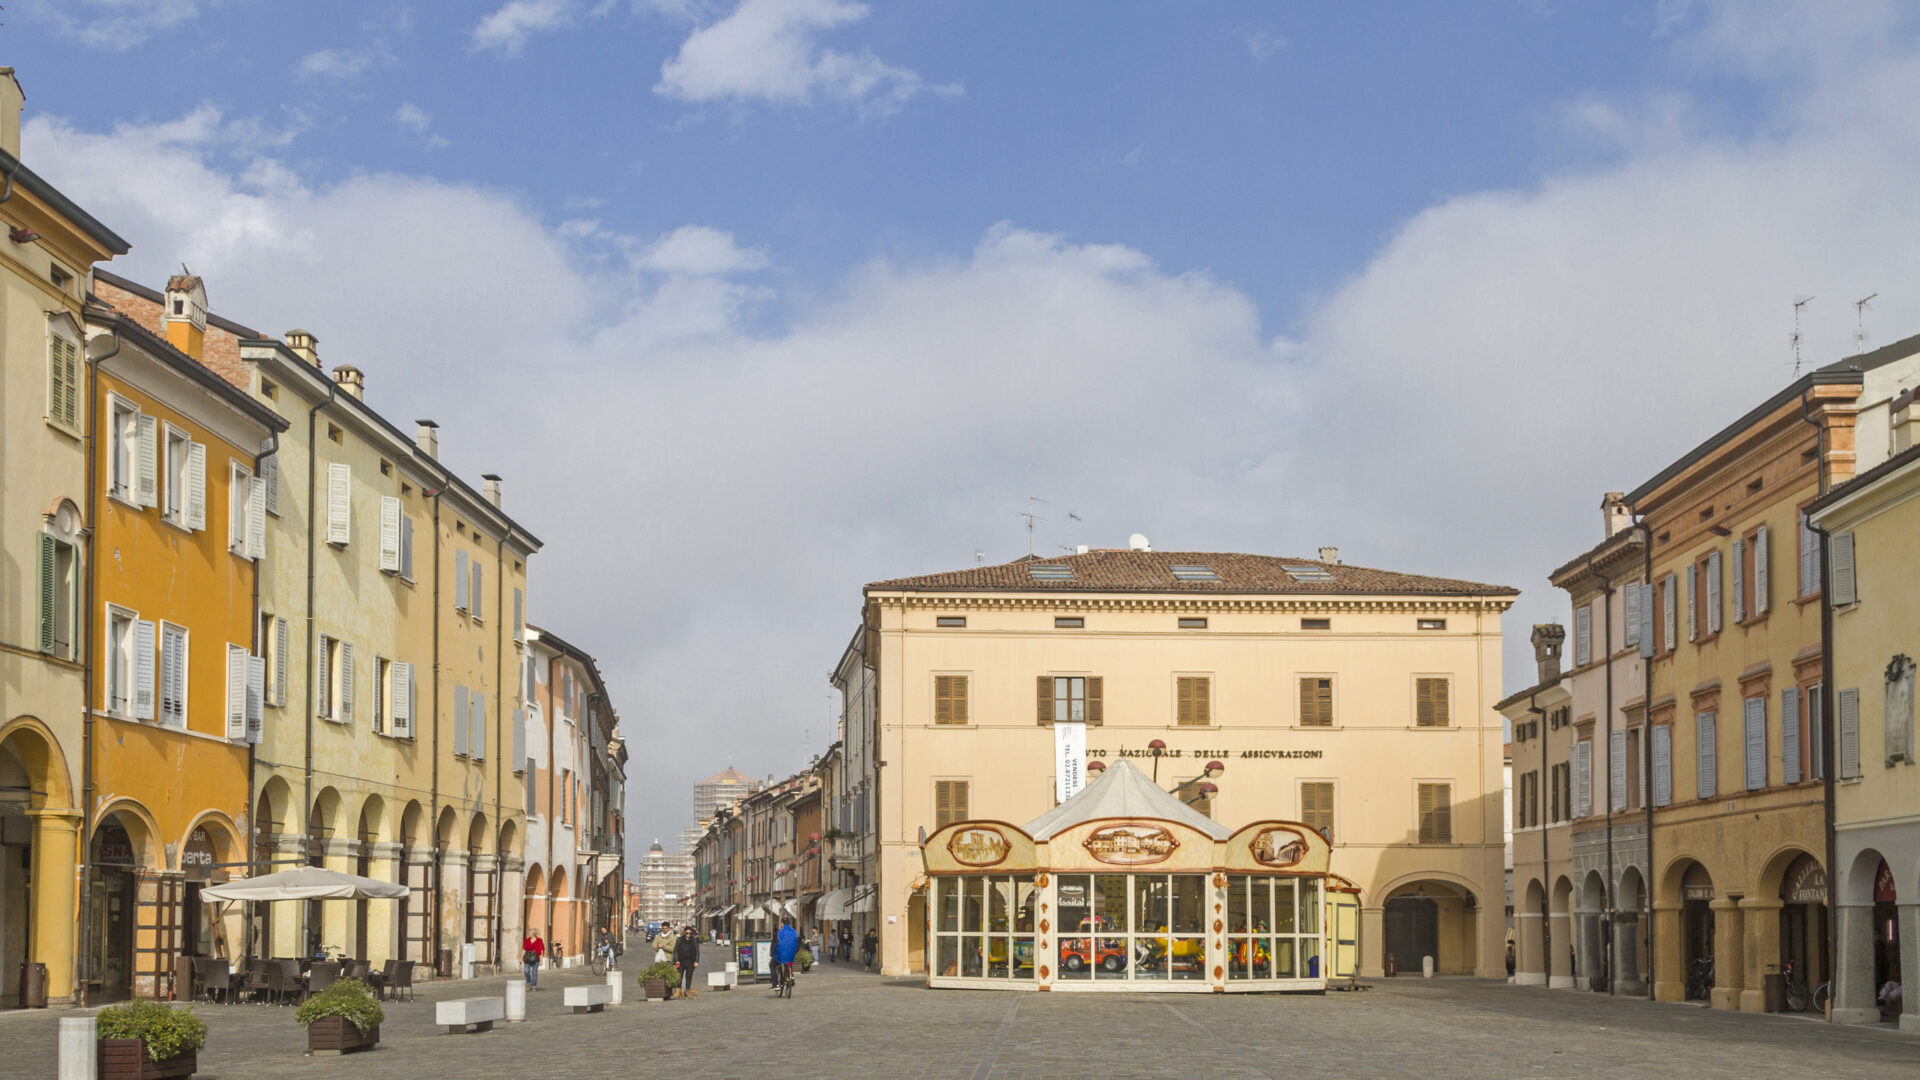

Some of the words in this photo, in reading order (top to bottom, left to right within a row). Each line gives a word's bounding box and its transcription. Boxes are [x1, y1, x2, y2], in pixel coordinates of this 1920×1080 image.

[1119, 749, 1182, 758] NAZIOALE
[1194, 750, 1229, 758] DELLE
[1240, 750, 1323, 759] ASSICVRAZIONI
[1815, 873, 1825, 886] LA
